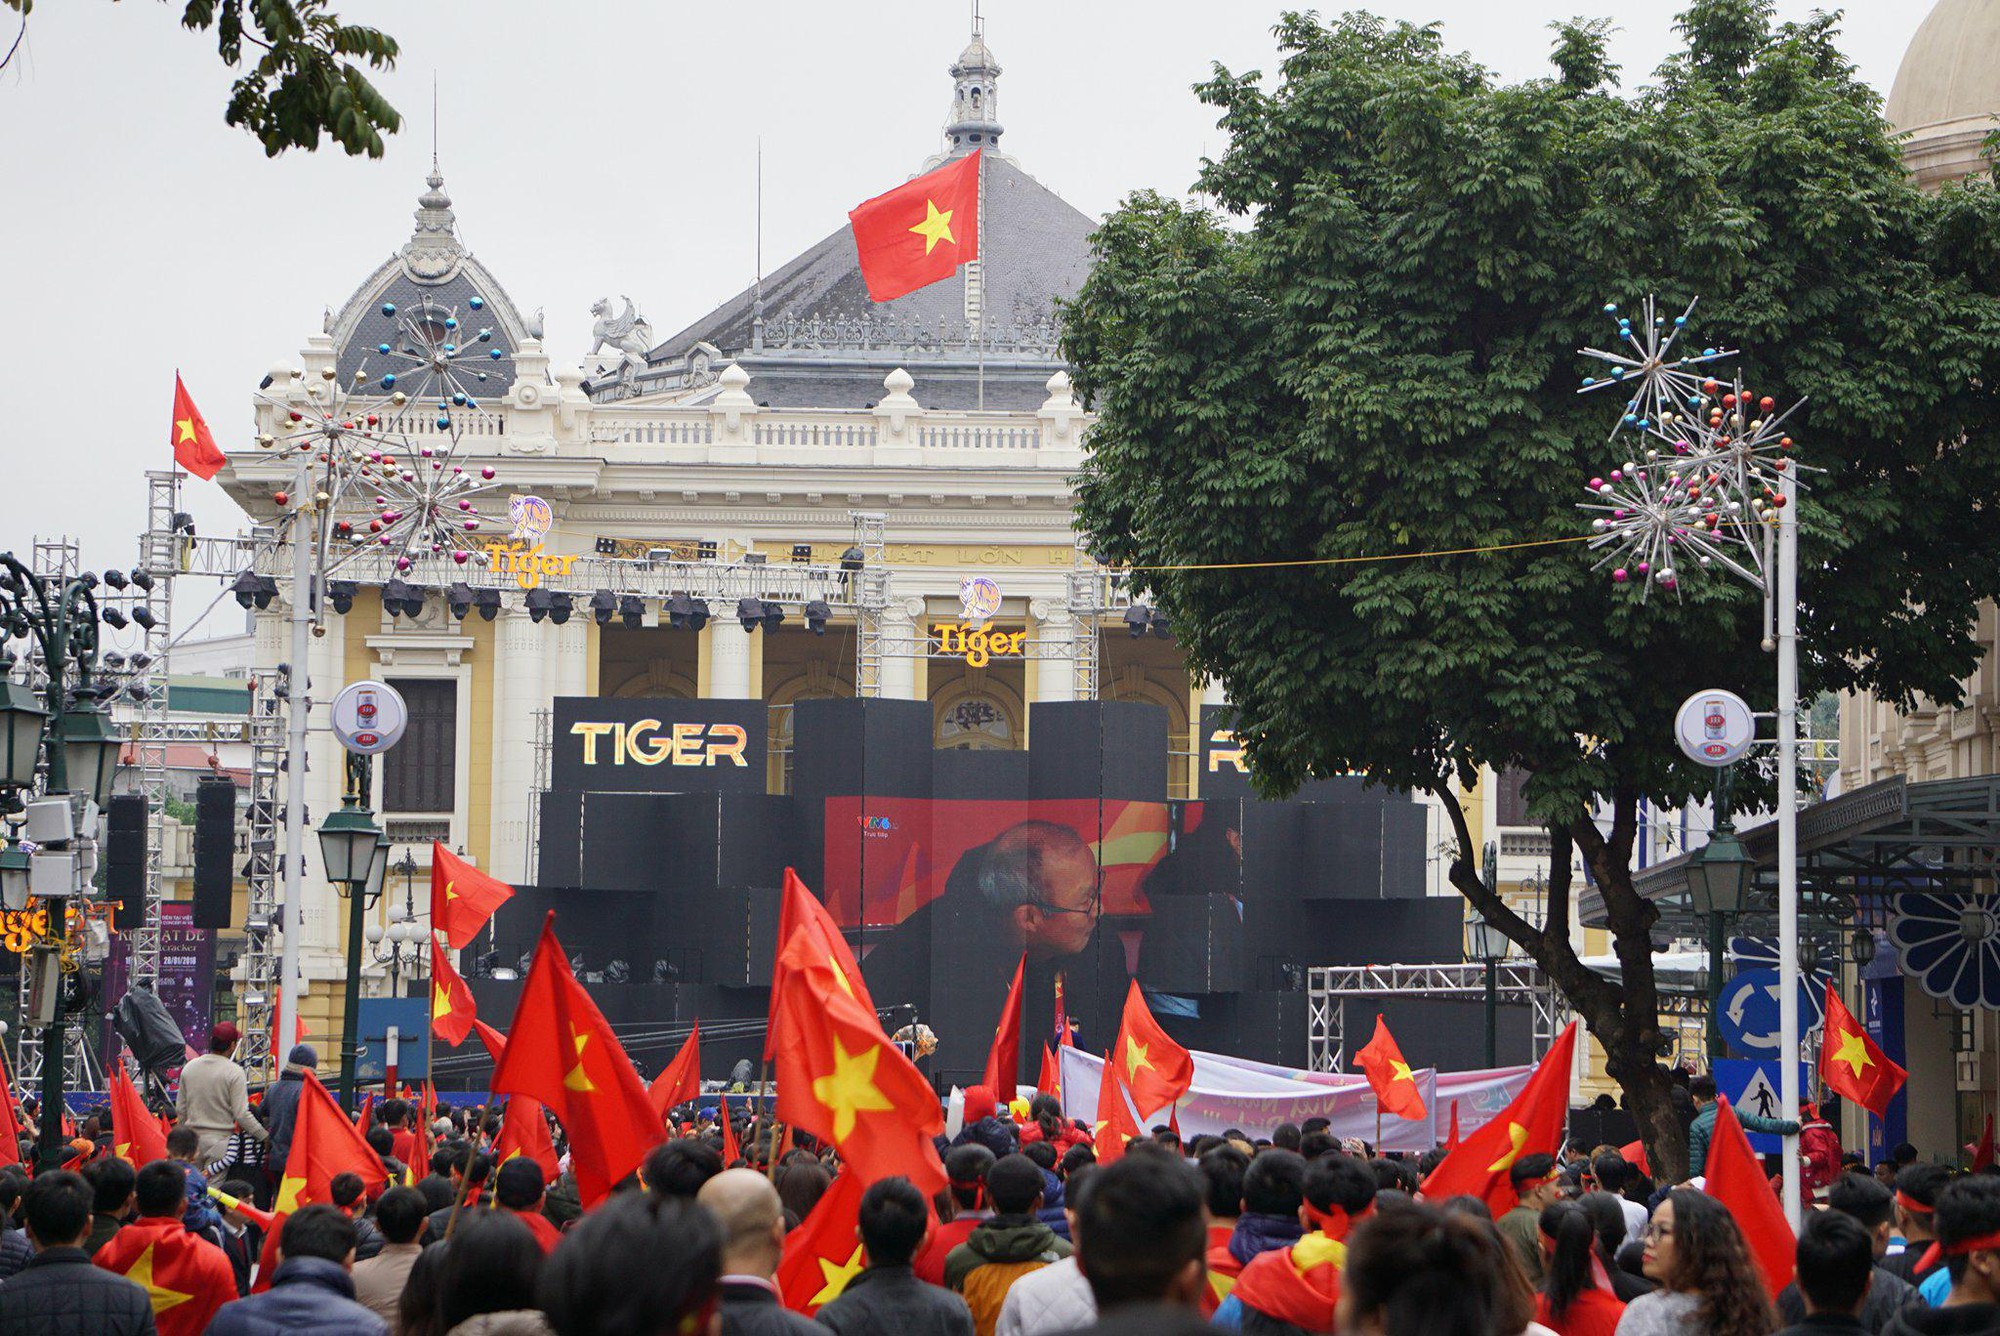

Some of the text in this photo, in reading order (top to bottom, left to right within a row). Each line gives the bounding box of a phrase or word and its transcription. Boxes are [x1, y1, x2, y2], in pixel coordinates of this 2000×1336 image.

[484, 543, 578, 589] Tiger
[956, 544, 1022, 564] LỚN
[934, 621, 1027, 668] Tiger
[570, 718, 748, 767] TIGER
